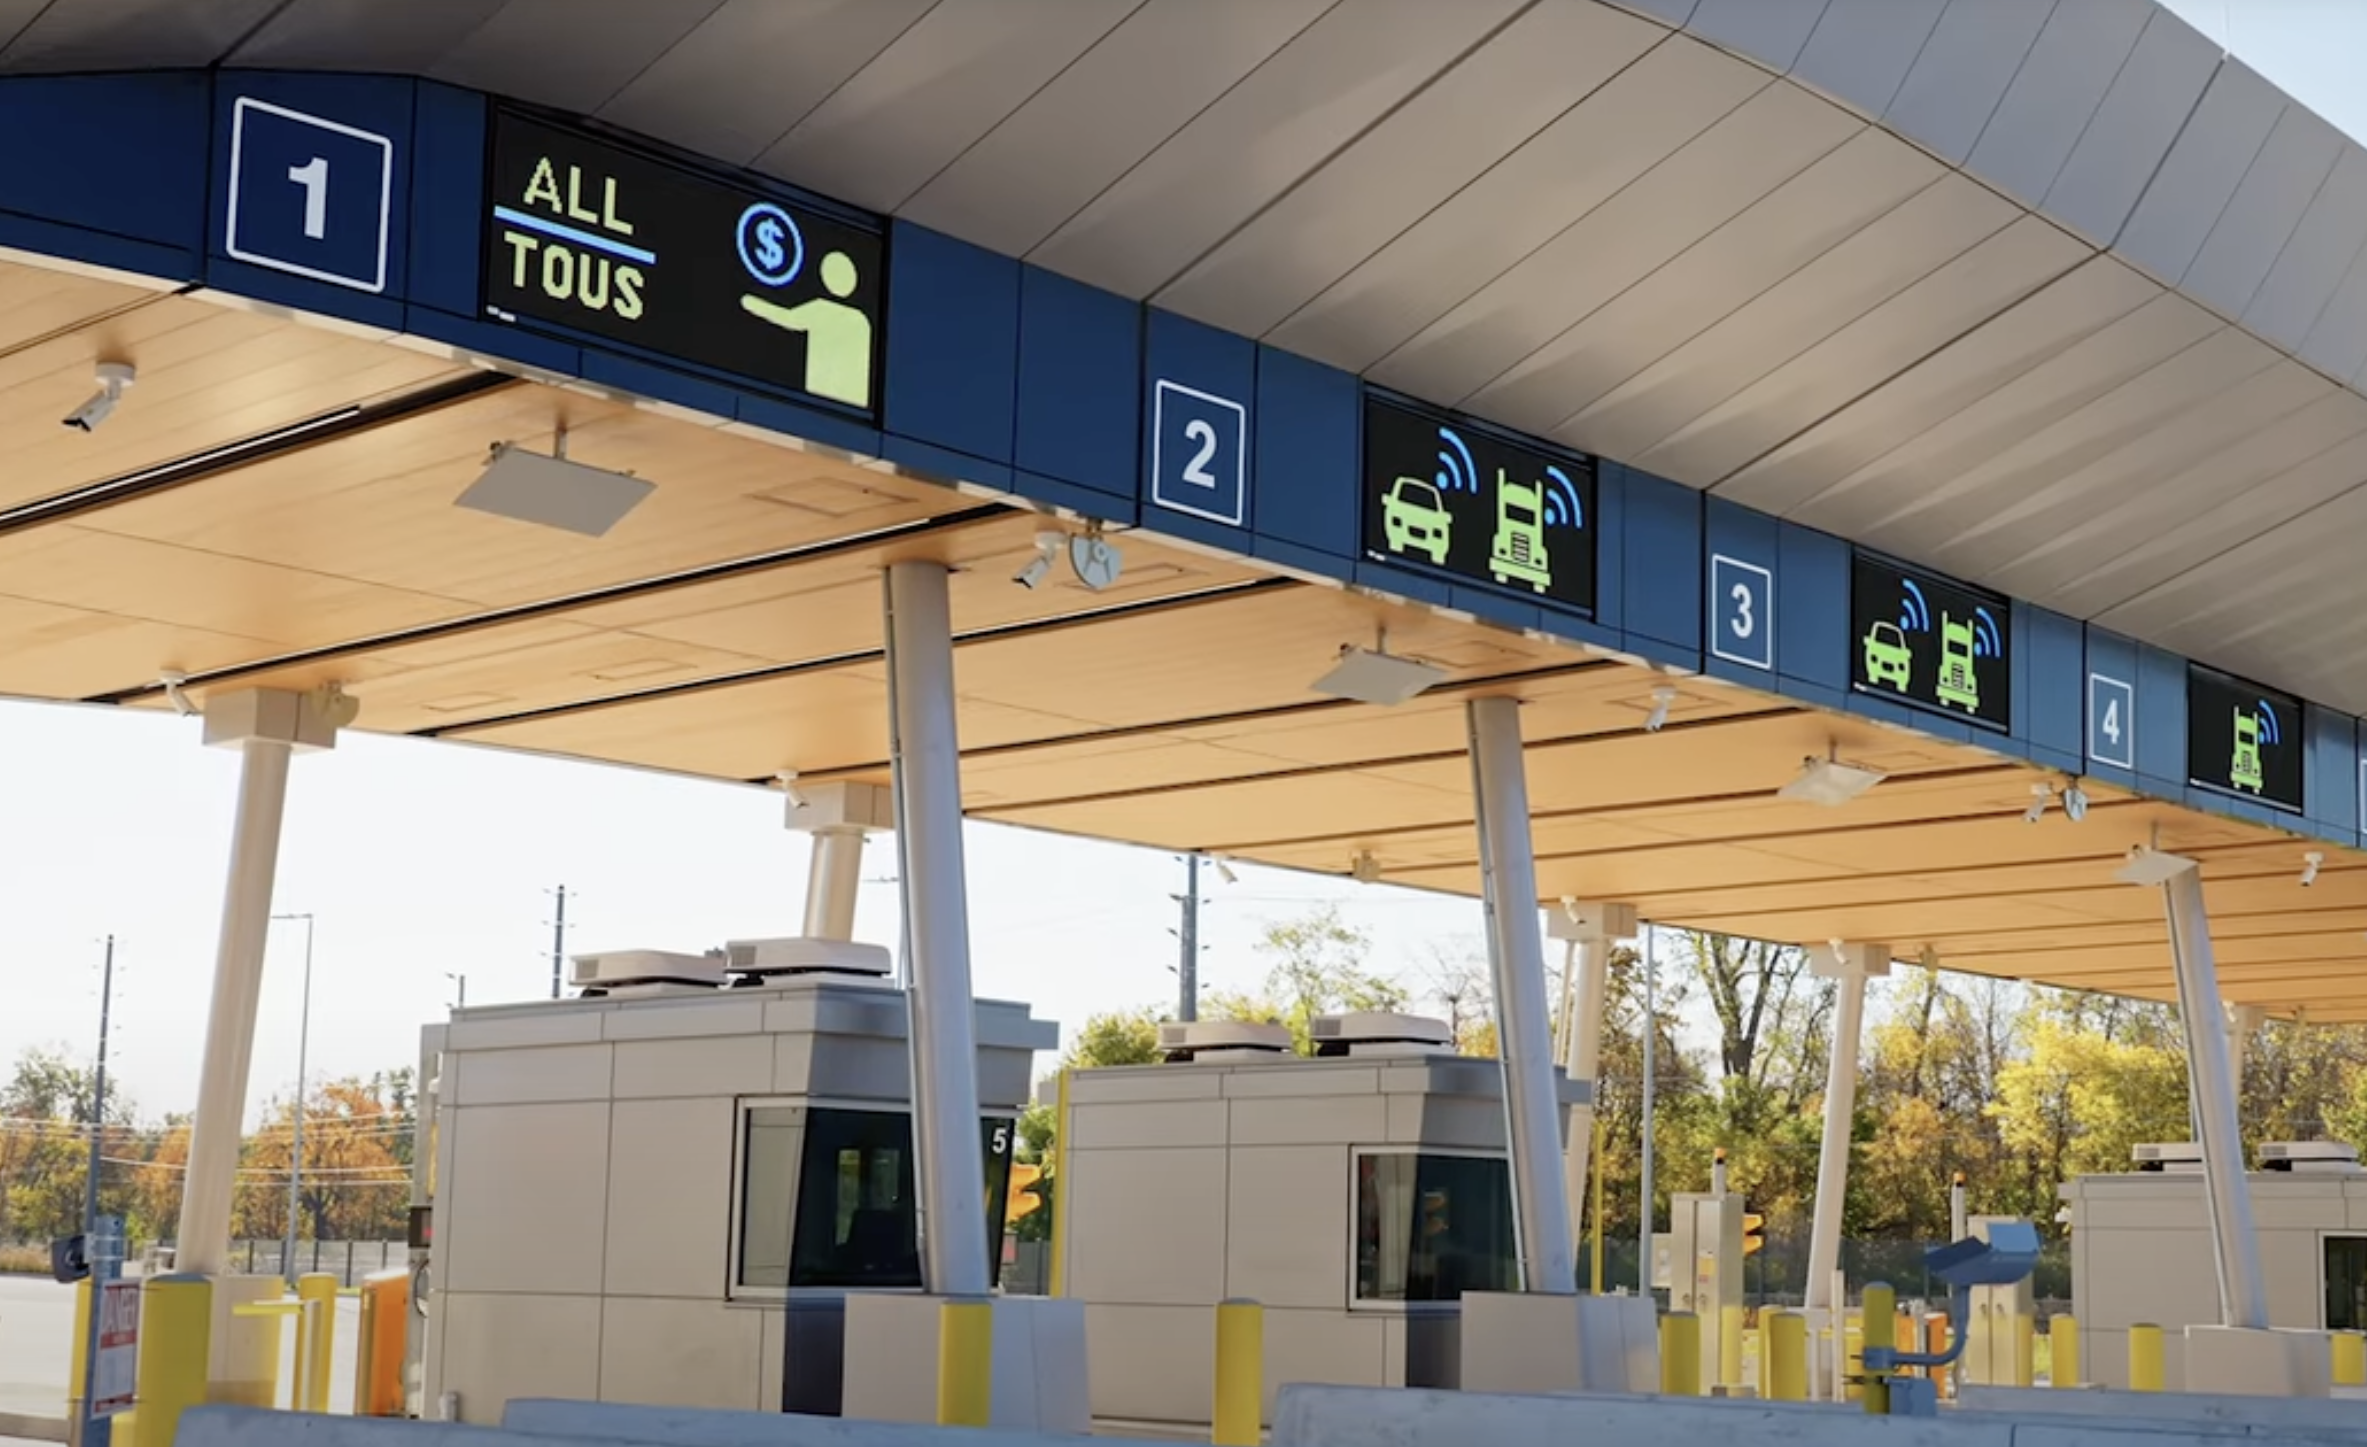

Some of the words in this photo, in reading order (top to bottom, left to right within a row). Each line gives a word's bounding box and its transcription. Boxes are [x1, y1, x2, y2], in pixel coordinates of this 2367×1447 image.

[289, 157, 328, 239] 1
[523, 156, 633, 236] ALL
[504, 231, 644, 320] TOUS
[1183, 420, 1216, 488] 2
[1731, 583, 1753, 638] 3
[2102, 699, 2120, 745] 4
[992, 1127, 1007, 1154] 5
